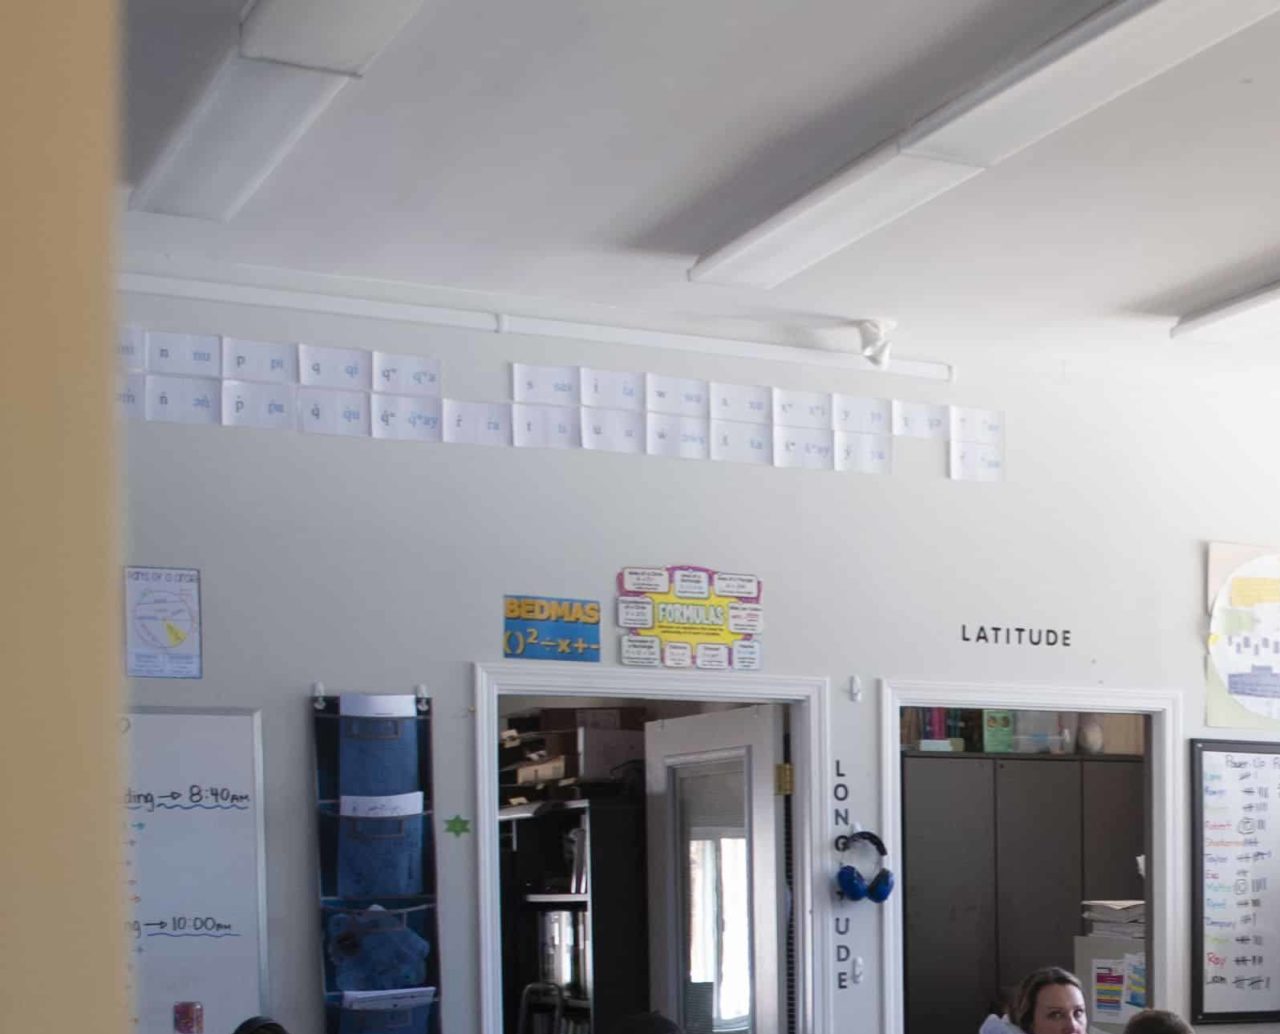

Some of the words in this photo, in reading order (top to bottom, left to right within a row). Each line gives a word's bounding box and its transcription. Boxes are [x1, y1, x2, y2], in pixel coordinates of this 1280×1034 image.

[504, 598, 600, 624] BEDMAS
[657, 603, 725, 625] FORMULAS
[962, 625, 1072, 647] LATITUDE
[833, 759, 851, 989] LONGUDE
